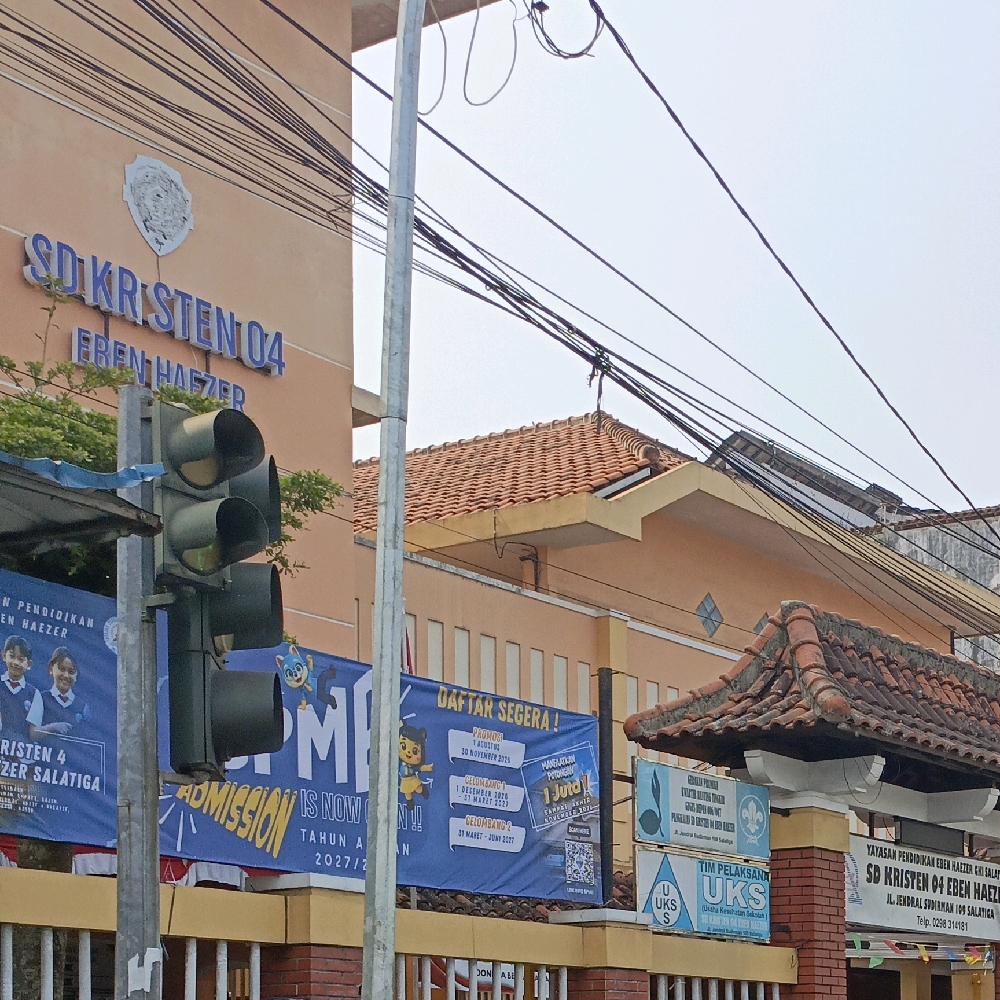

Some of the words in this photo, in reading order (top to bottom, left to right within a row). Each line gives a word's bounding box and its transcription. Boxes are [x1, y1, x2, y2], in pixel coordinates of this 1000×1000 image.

[24, 233, 79, 296] SD
[241, 320, 286, 378] 04
[17, 600, 94, 628] PENDIDIKAN
[22, 618, 68, 639] HAEZER
[437, 685, 494, 719] DAFTAR
[497, 700, 550, 731] SEGERA
[57, 749, 66, 765] 4
[33, 766, 100, 792] SALATIGA
[300, 788, 318, 819] IS
[321, 791, 361, 824] NOW
[176, 779, 297, 860] ADMISSION
[300, 828, 346, 847] TAHUN
[698, 860, 716, 873] TIM
[867, 844, 897, 861] YAYASAN
[898, 850, 935, 868] PENDIDIKAN
[936, 857, 950, 871] EBEN
[662, 884, 670, 896] U
[703, 874, 767, 911] UKS
[866, 862, 881, 885] SD
[884, 865, 929, 892] KRISTEN
[931, 874, 944, 895] 04
[947, 877, 970, 900] EBEN
[655, 897, 677, 911] UKS
[896, 894, 923, 910] JENDRAL
[924, 898, 954, 914] SUDIRMAN
[967, 905, 995, 920] SALATIGA
[663, 912, 670, 924] S
